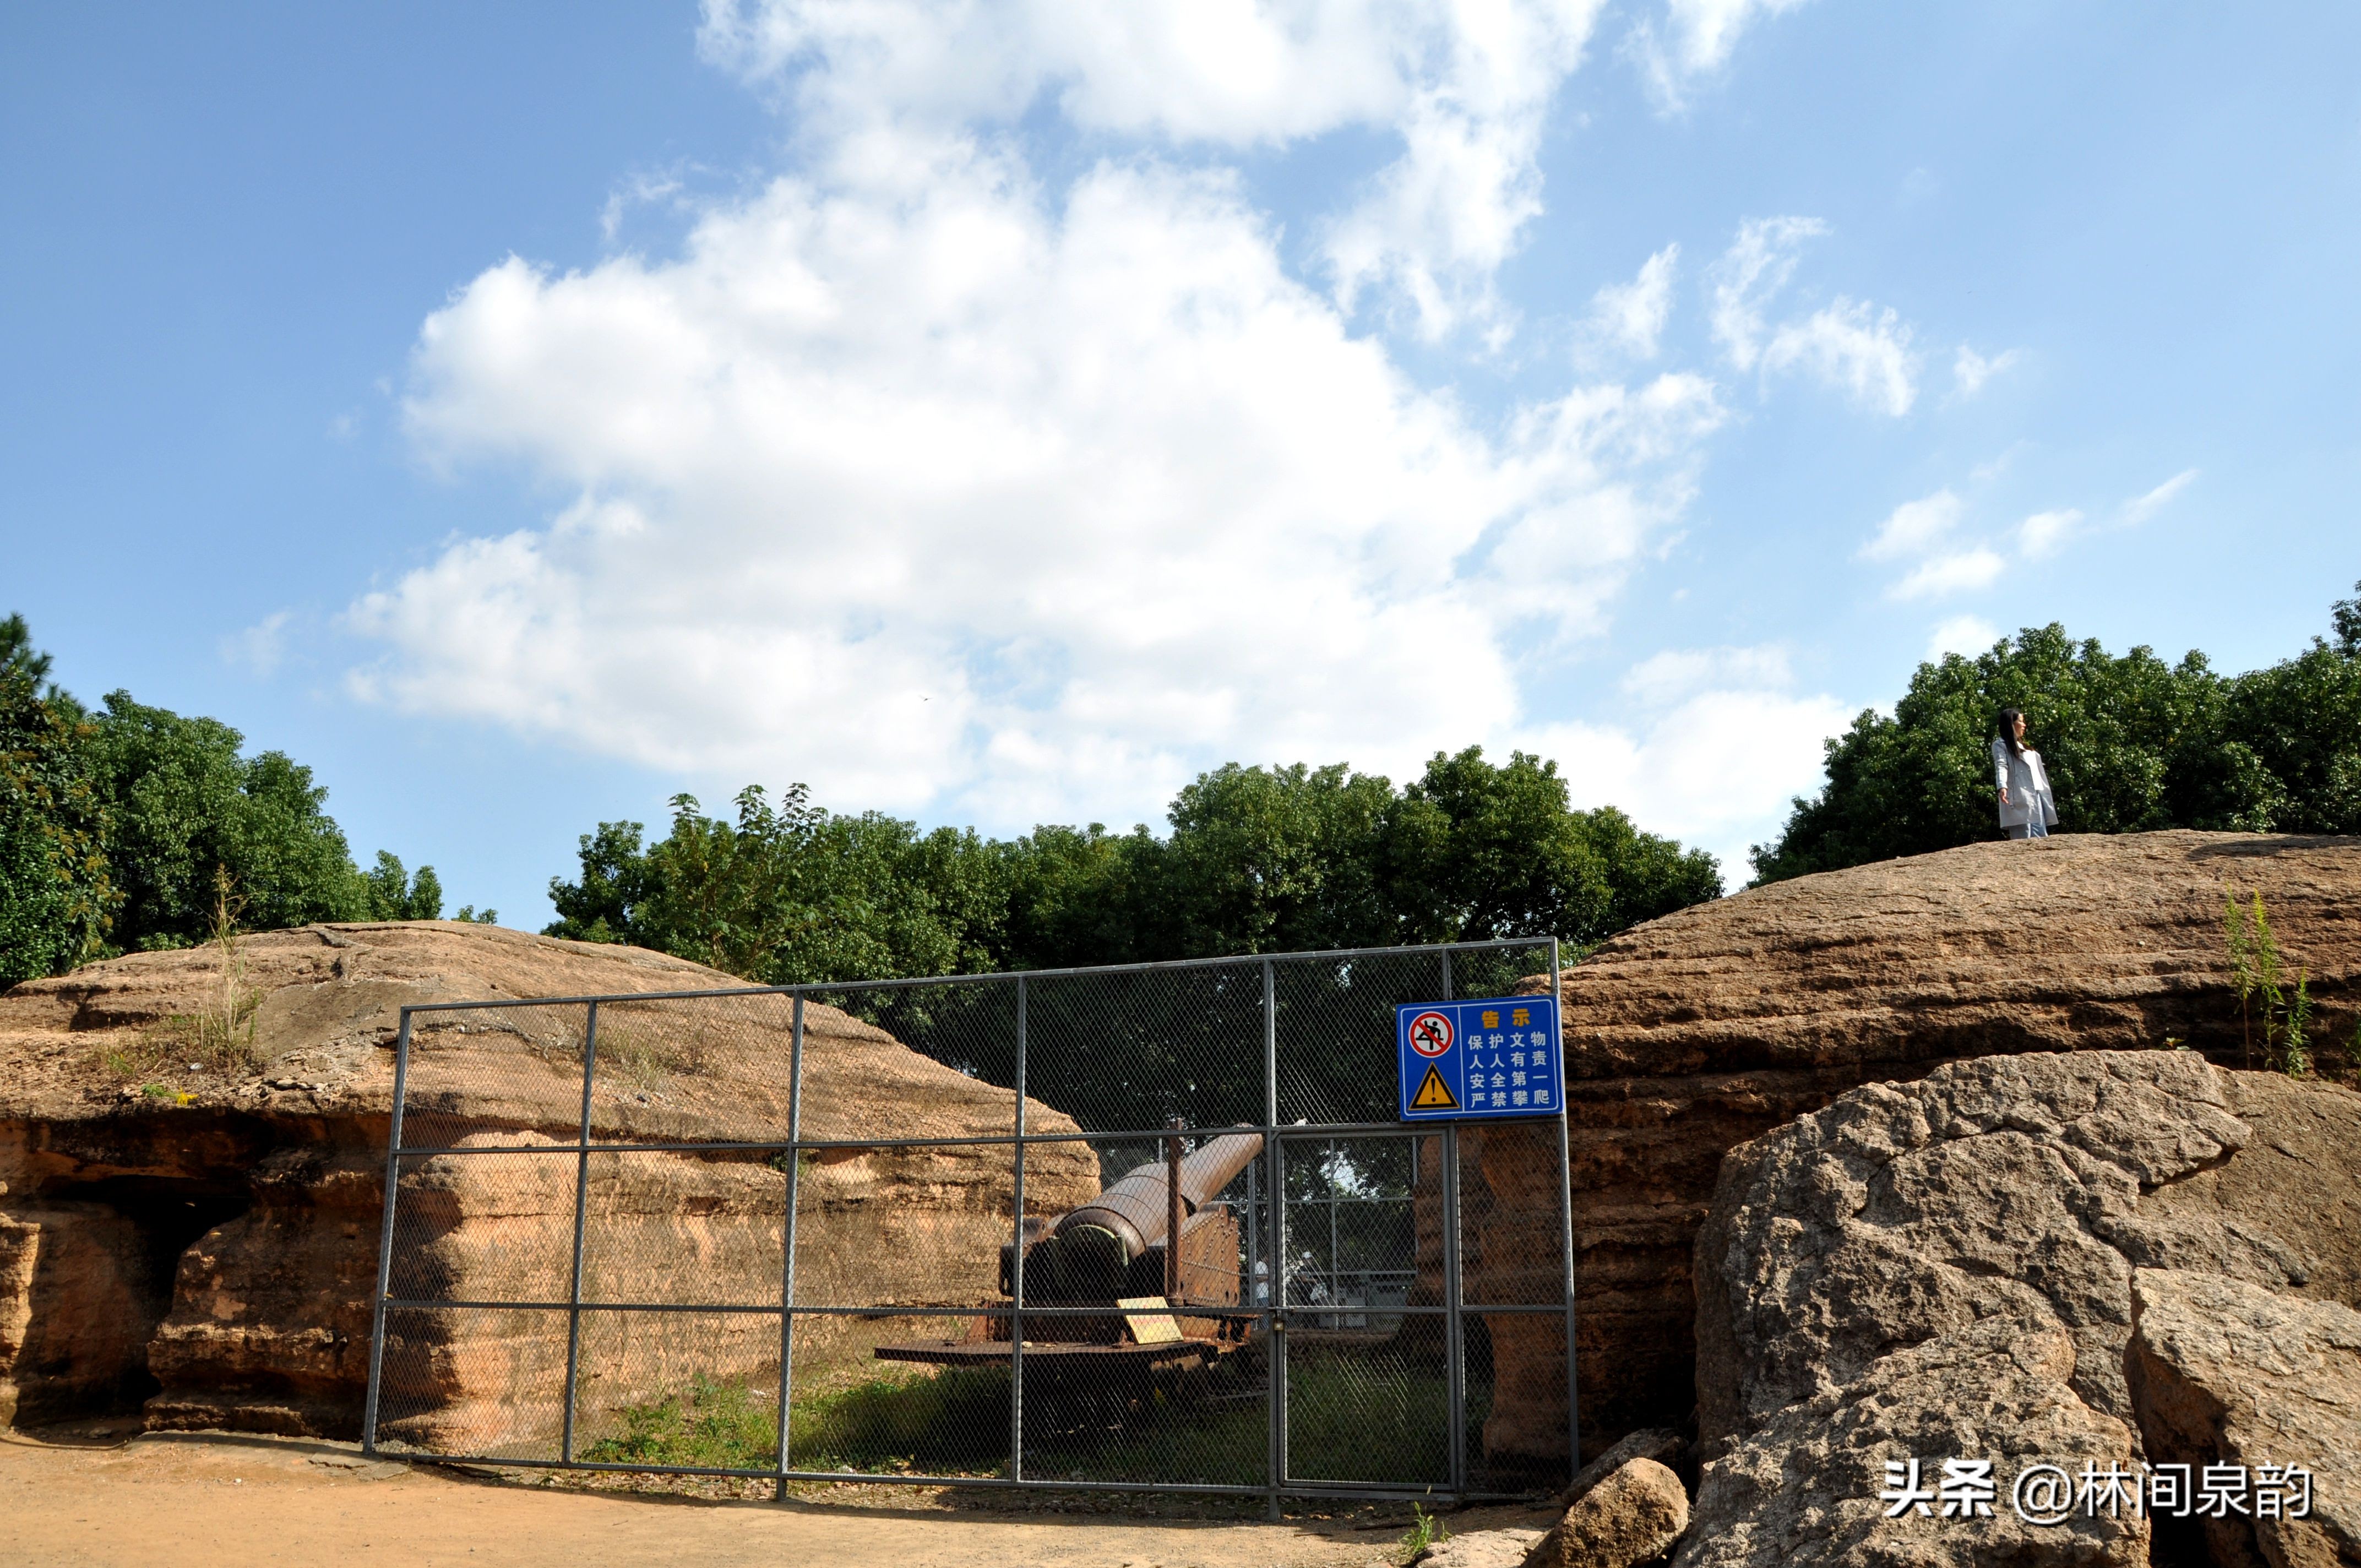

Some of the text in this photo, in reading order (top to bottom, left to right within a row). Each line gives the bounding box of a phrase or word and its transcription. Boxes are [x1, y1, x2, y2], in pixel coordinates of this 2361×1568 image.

[1482, 1009, 1530, 1029] 告示
[1468, 1031, 1546, 1050] 保护文物
[1469, 1051, 1547, 1069] 人人有责
[1470, 1071, 1548, 1088] 安全第一
[1471, 1090, 1549, 1108] 严禁攀爬
